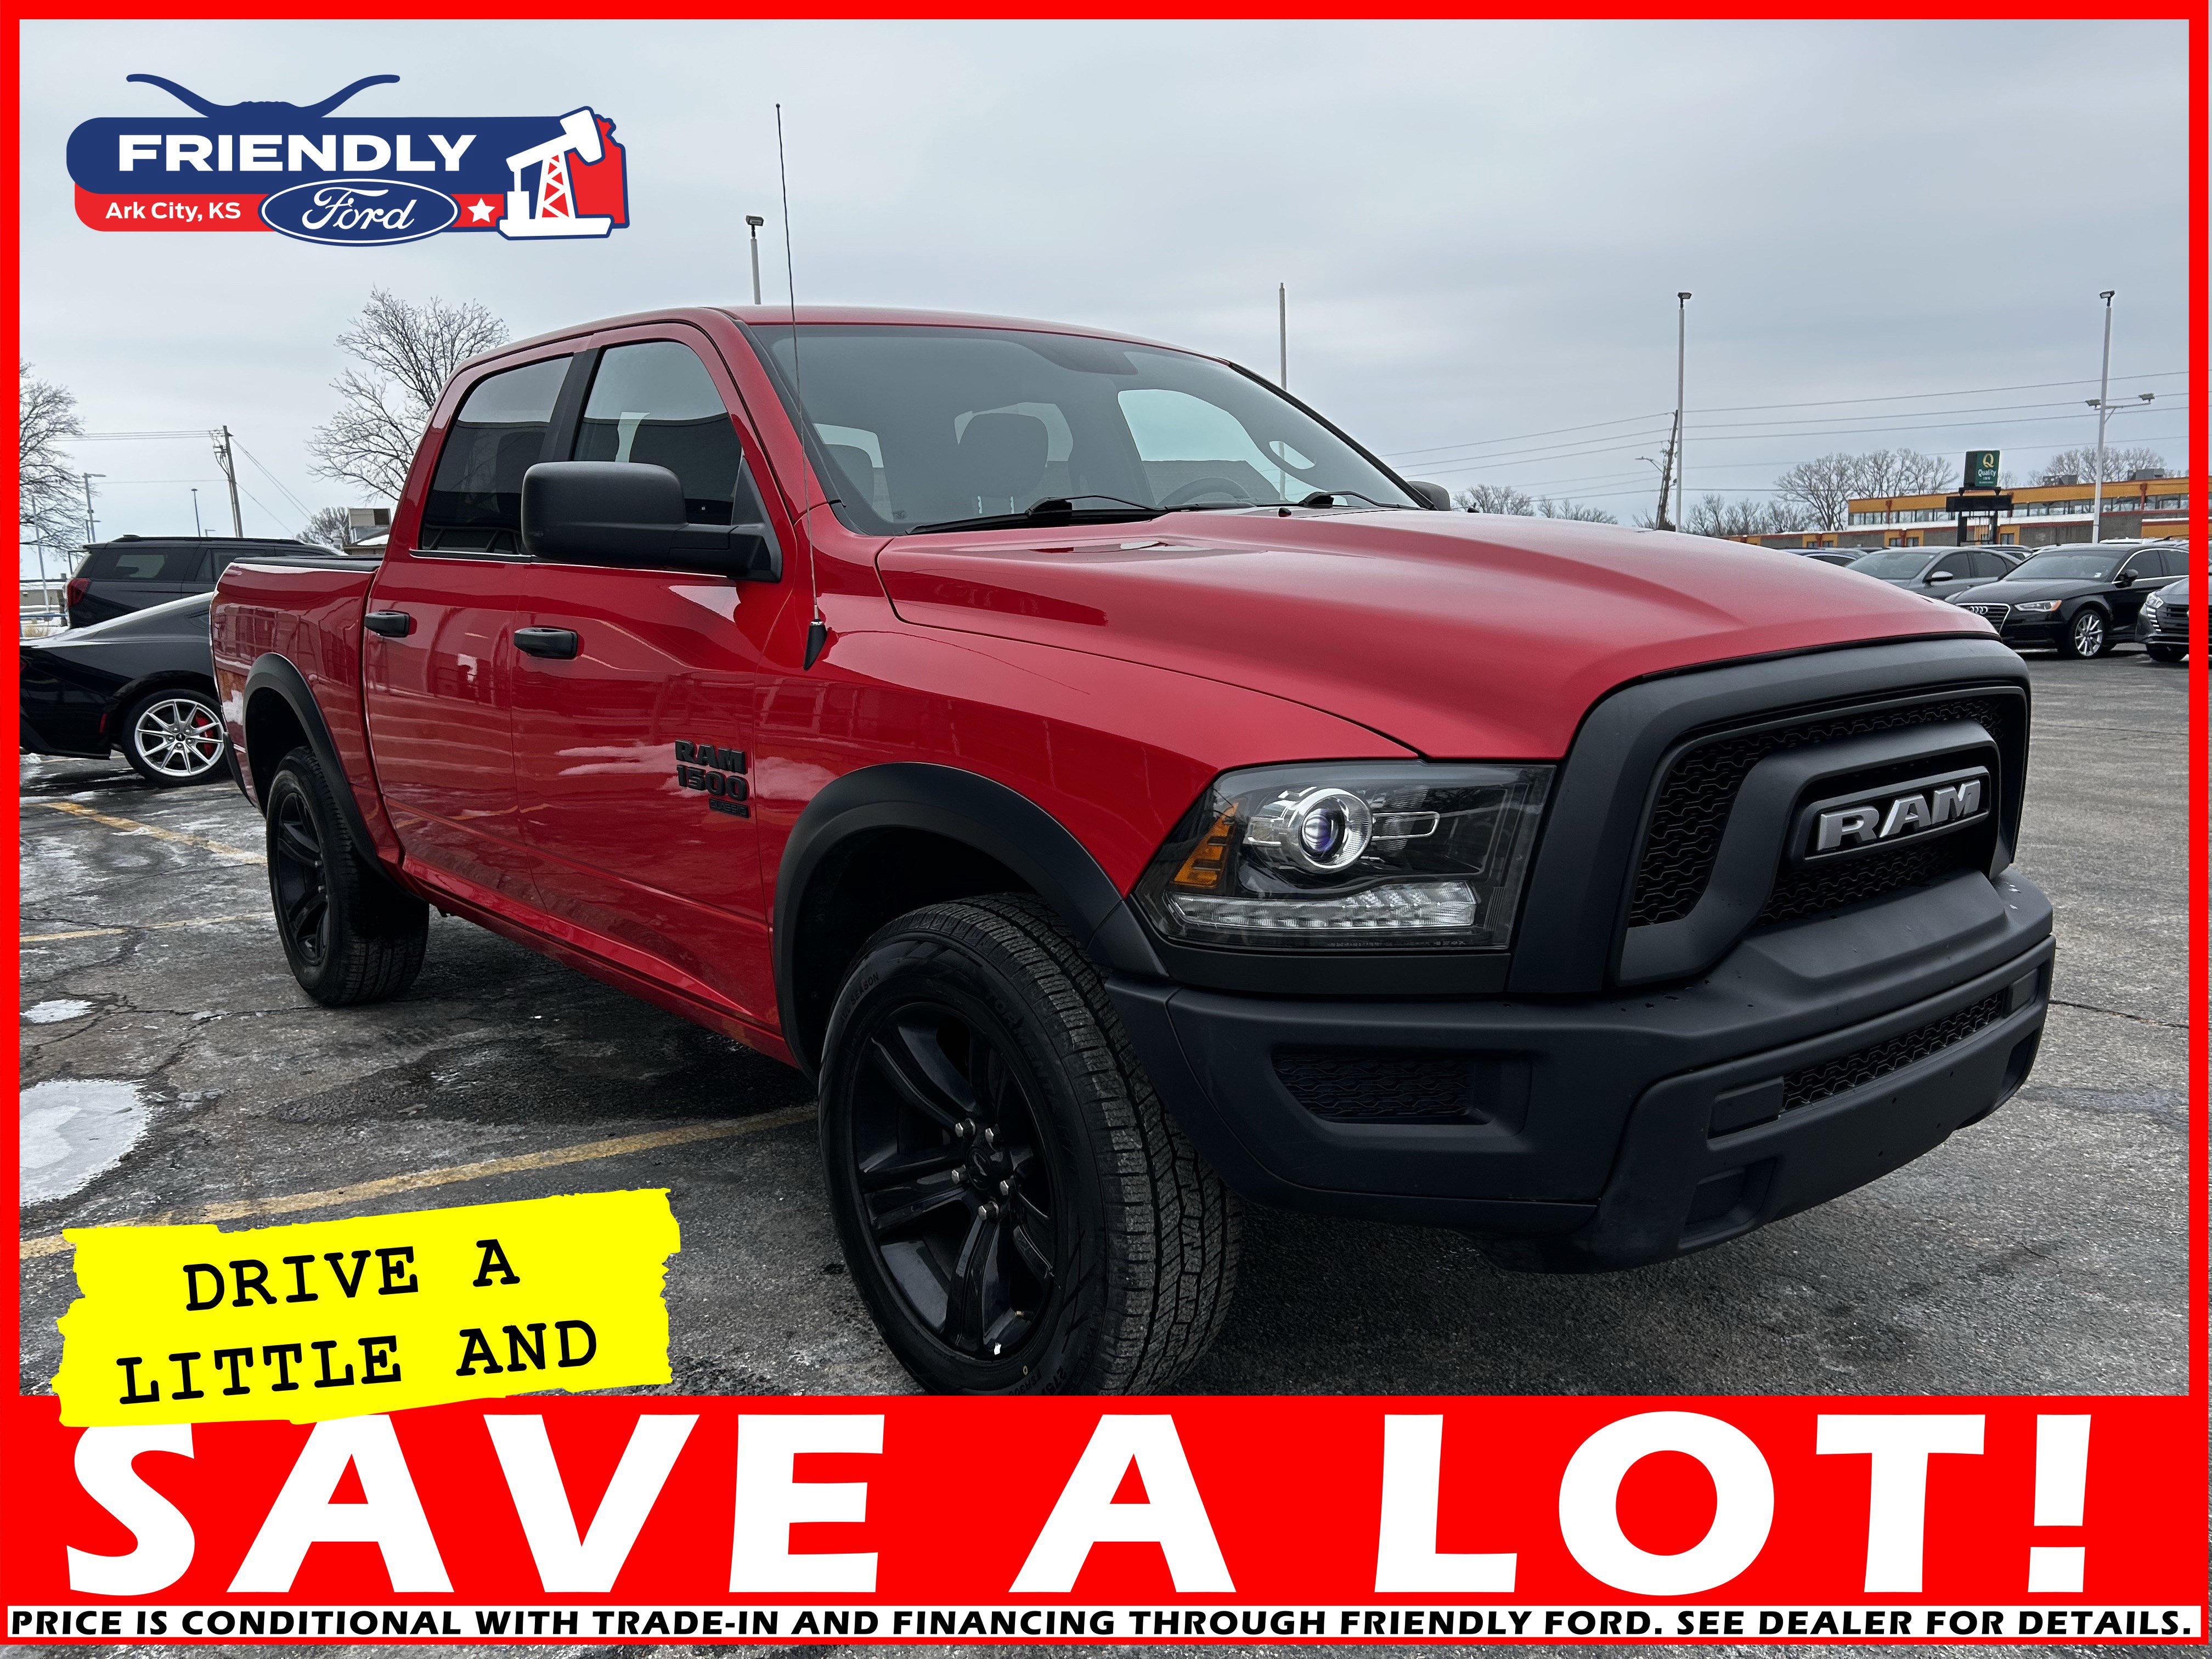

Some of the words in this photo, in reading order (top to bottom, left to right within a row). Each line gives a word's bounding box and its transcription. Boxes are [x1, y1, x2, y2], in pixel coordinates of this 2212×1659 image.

[1978, 469, 1996, 477] Quality
[1983, 453, 1994, 468] Q
[675, 739, 748, 775] RAM
[676, 764, 749, 801] 1500
[1816, 779, 1980, 851] RAM
[851, 972, 879, 1005] SEASON
